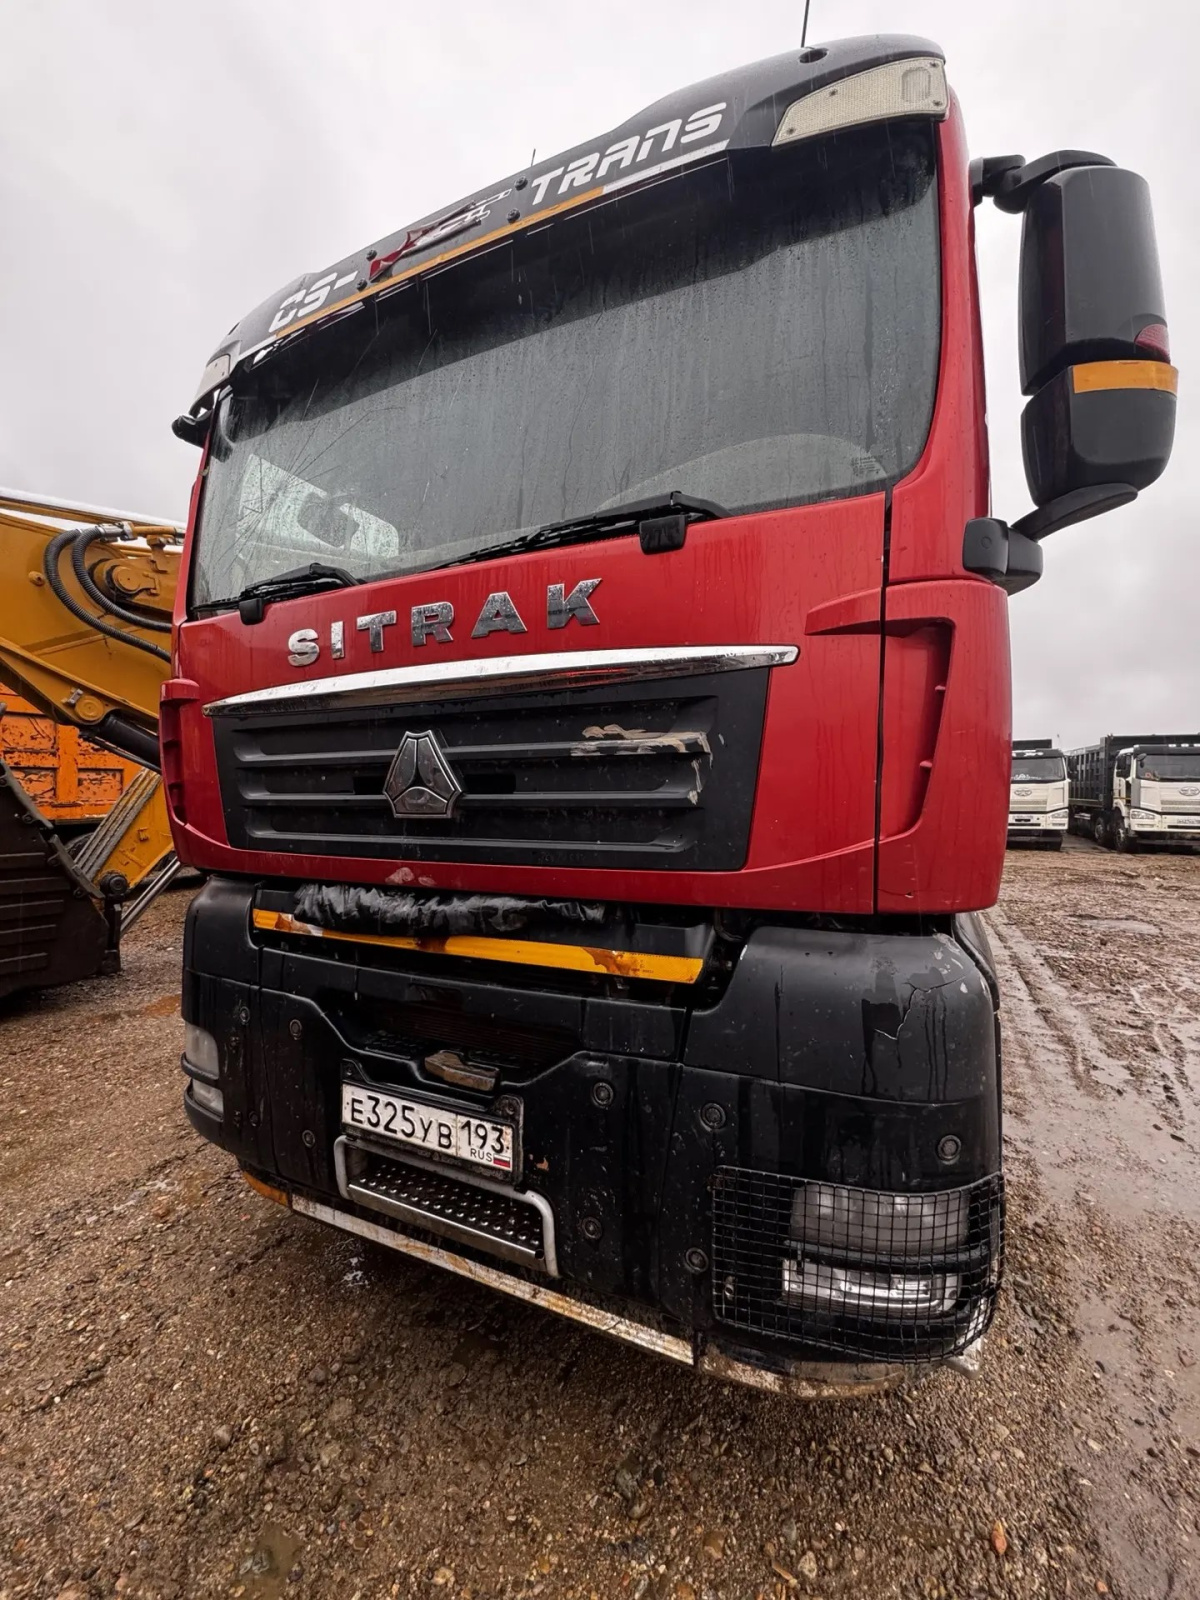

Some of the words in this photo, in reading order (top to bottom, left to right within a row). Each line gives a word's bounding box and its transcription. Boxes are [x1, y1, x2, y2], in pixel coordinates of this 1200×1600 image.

[531, 102, 727, 206] TRANS
[287, 578, 602, 667] SITRAK
[460, 1119, 505, 1154] 193
[470, 1148, 493, 1163] RUS
